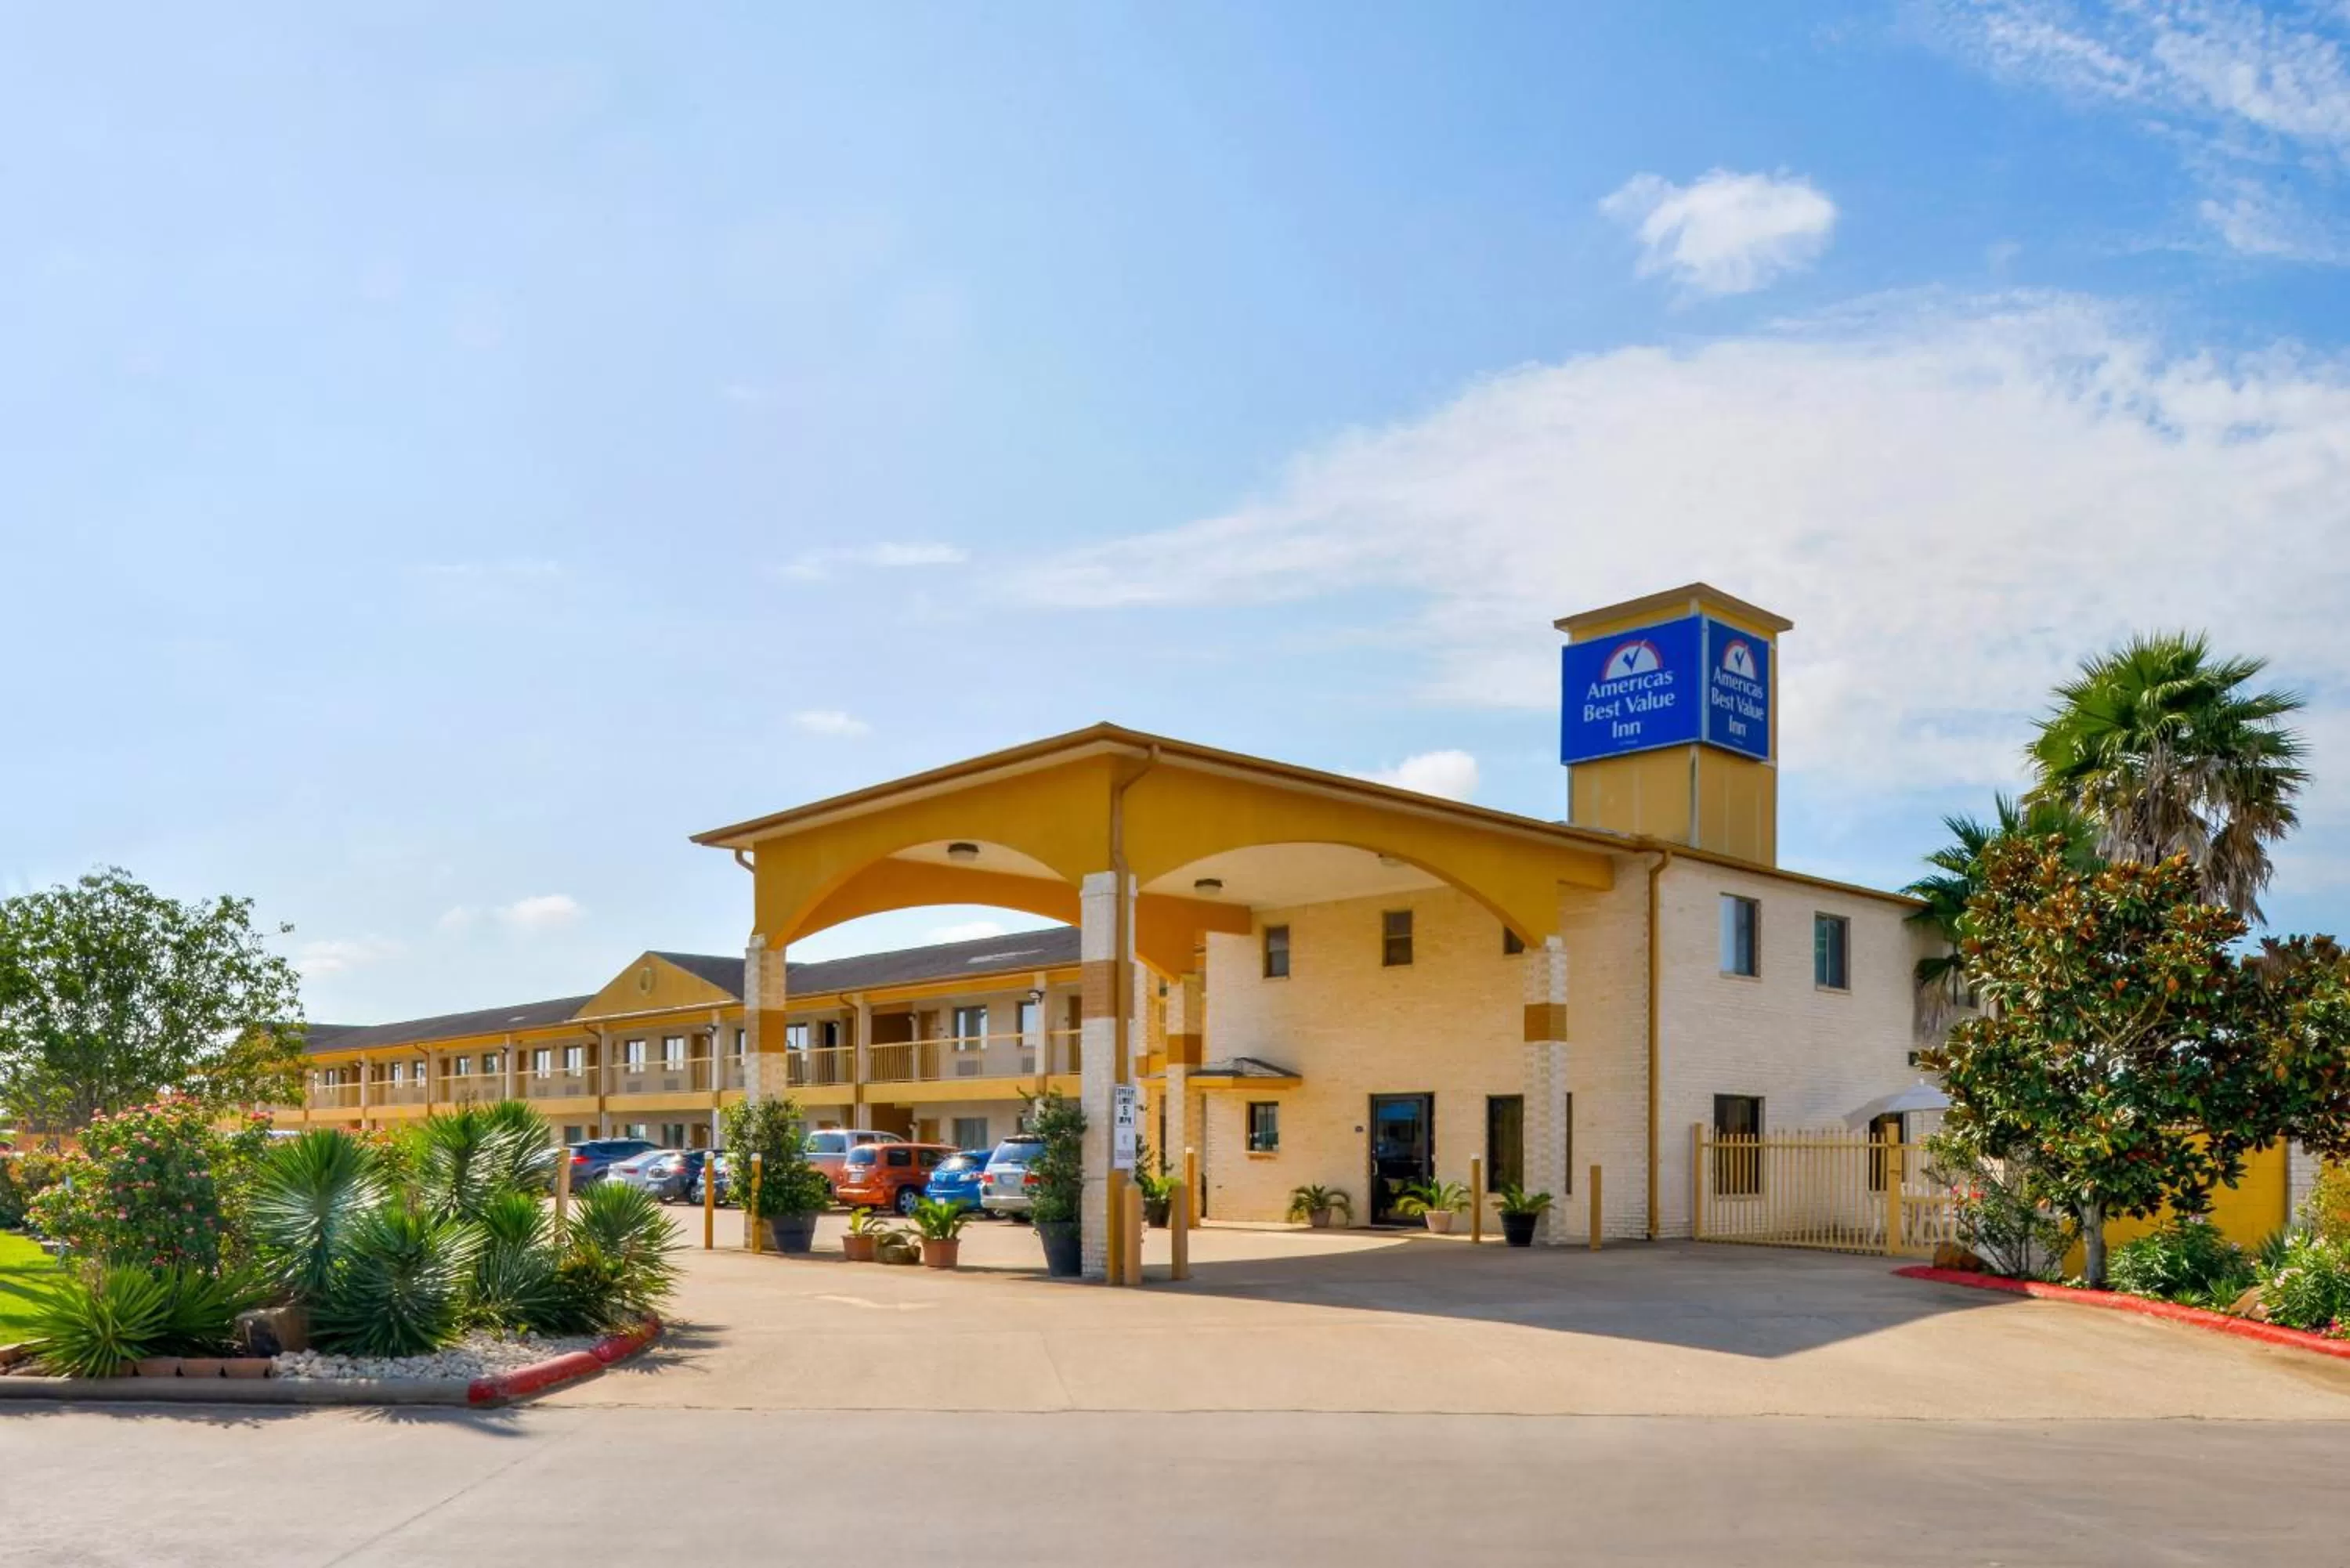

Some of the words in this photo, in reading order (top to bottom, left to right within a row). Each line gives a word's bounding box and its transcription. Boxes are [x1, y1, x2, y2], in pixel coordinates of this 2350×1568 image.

[1587, 670, 1673, 700] Americas
[1713, 666, 1762, 699] Americas
[1583, 698, 1619, 722] Best
[1625, 691, 1675, 714] Value
[1712, 688, 1734, 712] Best
[1737, 696, 1764, 721] Value
[1612, 721, 1640, 739] Inn
[1729, 715, 1746, 737] Inn
